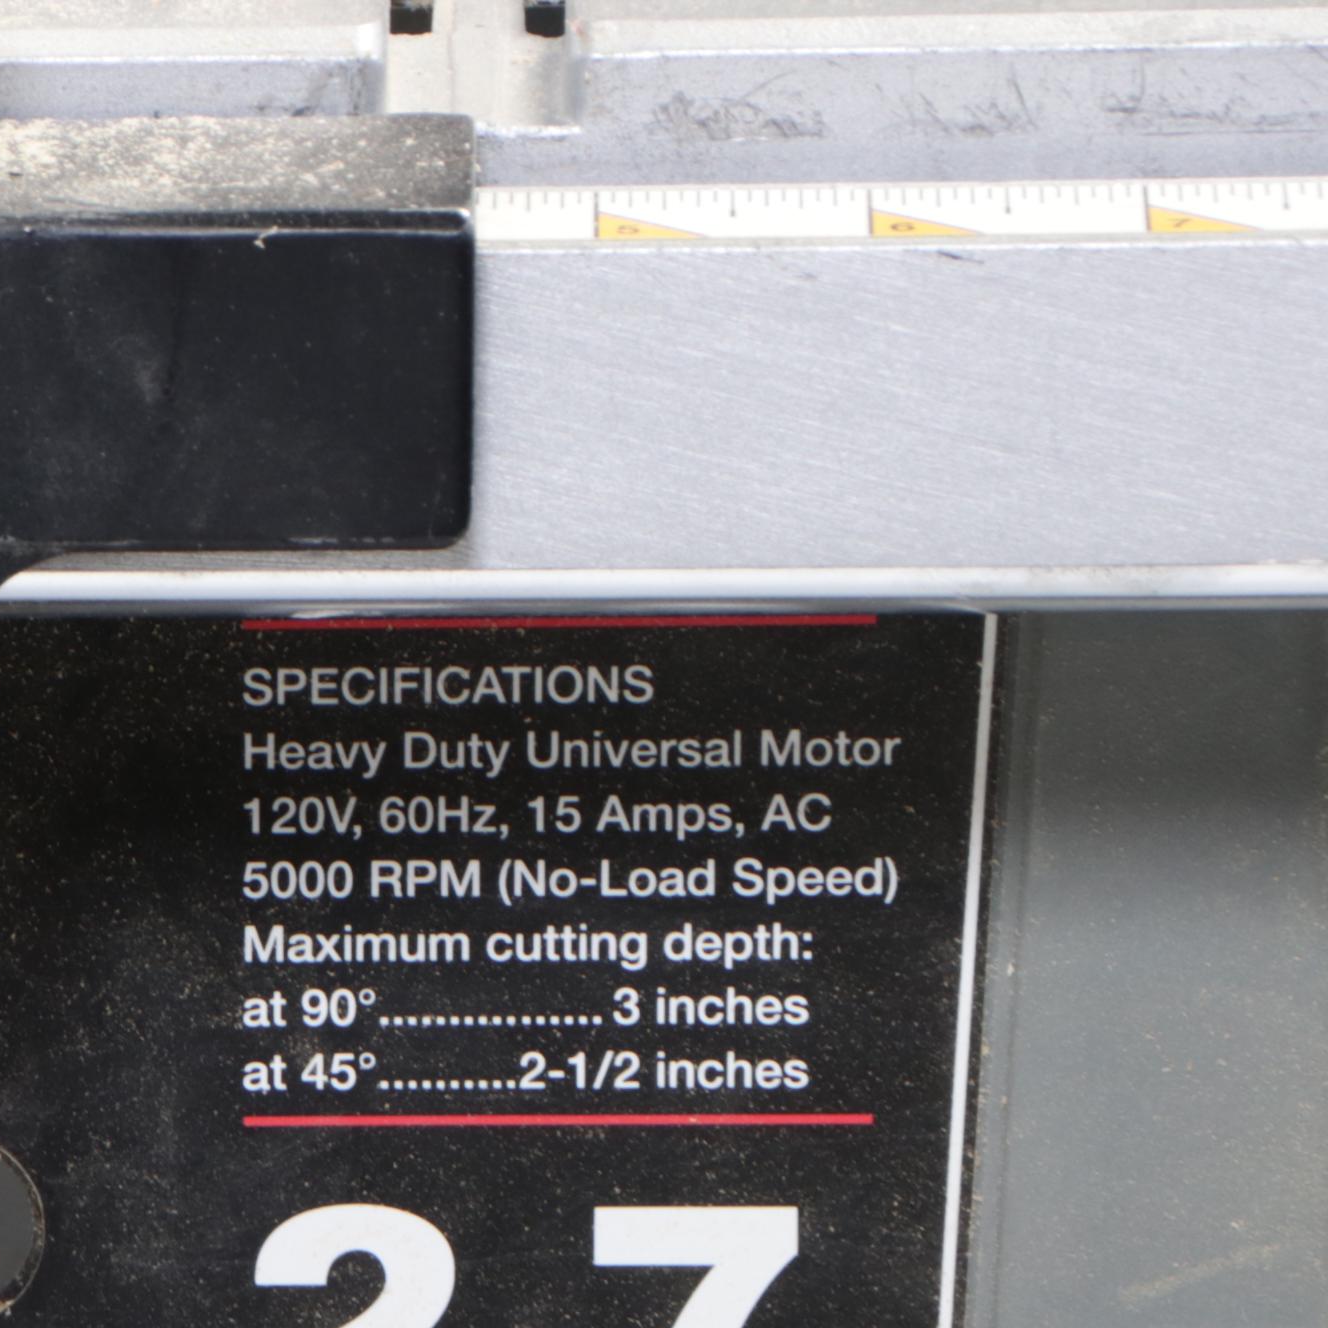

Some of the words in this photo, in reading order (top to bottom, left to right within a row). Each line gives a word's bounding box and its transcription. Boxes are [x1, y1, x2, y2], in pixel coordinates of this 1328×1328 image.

[244, 665, 653, 705] SPECIFICATIONS
[245, 733, 386, 778] Heavy
[405, 732, 509, 777] Duty
[528, 730, 741, 768] Universal
[761, 729, 901, 766] Motor
[245, 797, 361, 839] 120V,
[380, 796, 508, 839] 60Hz,
[529, 796, 581, 832] 15
[597, 795, 744, 840] Amps,
[762, 793, 831, 831] AC
[243, 861, 353, 899] 5000
[371, 860, 480, 897] RPM
[499, 859, 715, 905] (No-Load
[733, 857, 898, 904] Speed)
[244, 925, 469, 963] Maximum
[487, 924, 647, 970] cutting
[664, 923, 812, 969] depth:
[243, 991, 286, 1027] at
[613, 987, 640, 1025] 3
[657, 987, 809, 1025] inches
[243, 1055, 286, 1094] at
[657, 1051, 809, 1089] inches
